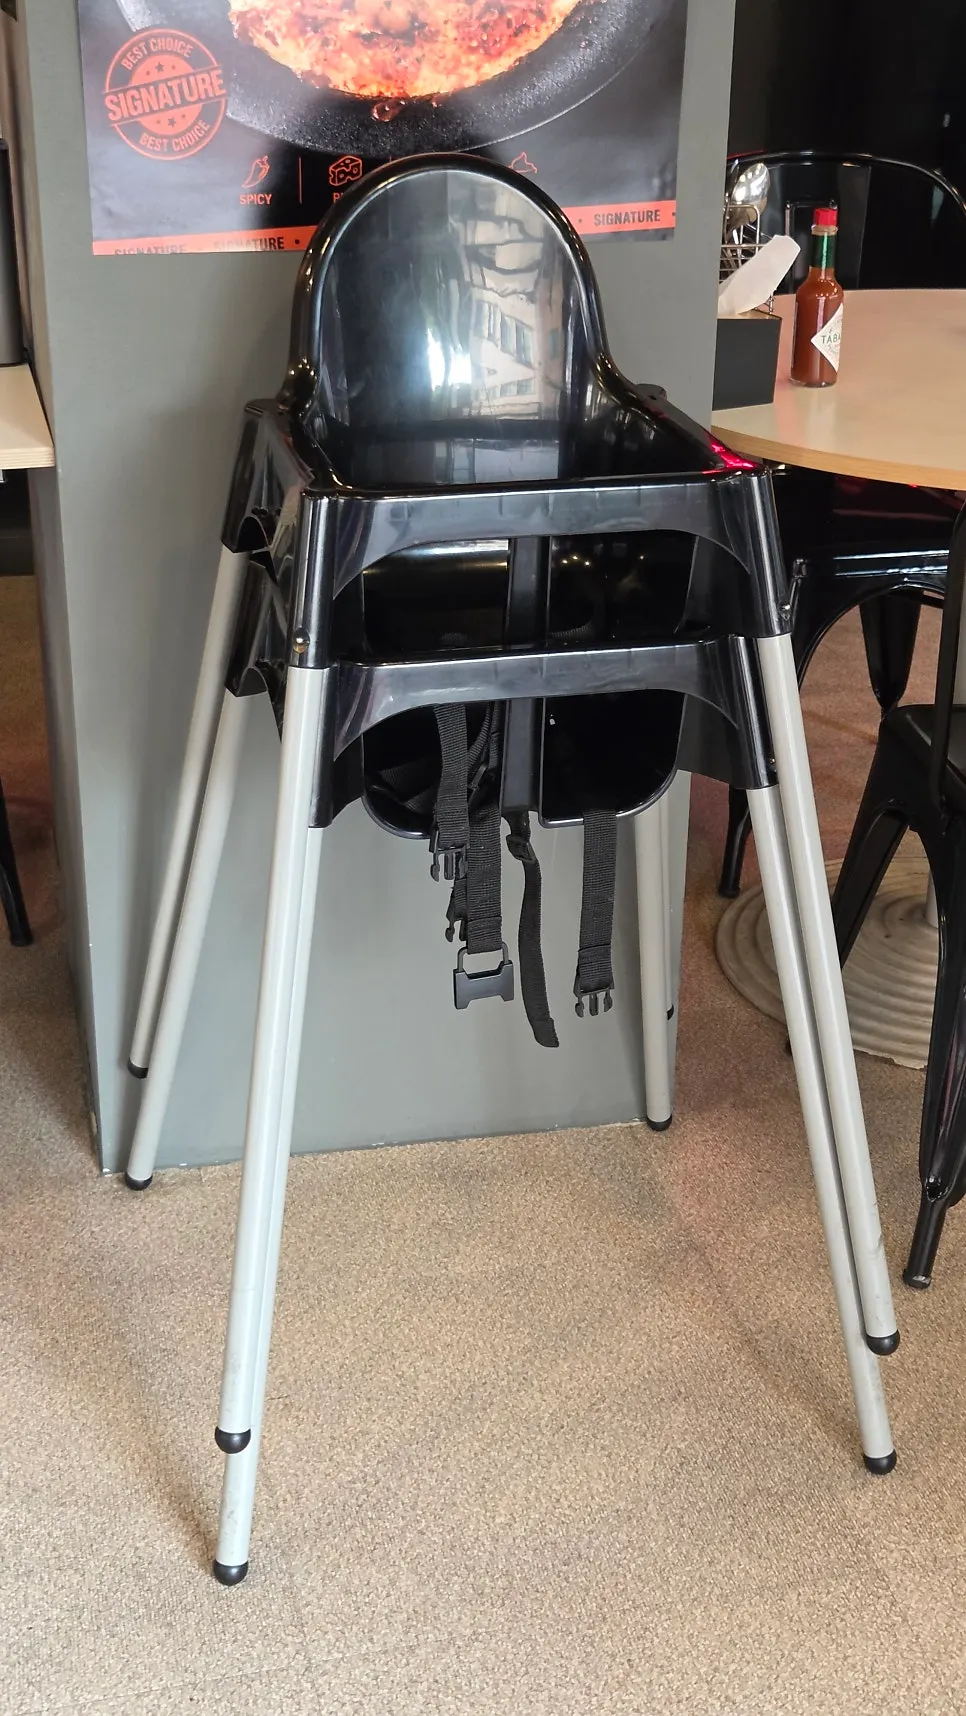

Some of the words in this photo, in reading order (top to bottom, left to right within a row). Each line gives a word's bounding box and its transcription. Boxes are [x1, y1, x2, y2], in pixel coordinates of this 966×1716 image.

[121, 42, 148, 70] BEST
[149, 38, 194, 58] CHOICE
[105, 69, 227, 121] SIGNATURE
[139, 133, 169, 152] BEST
[171, 120, 211, 152] CHOICE
[239, 193, 272, 205] SPICY
[594, 209, 661, 226] SIGNATURE
